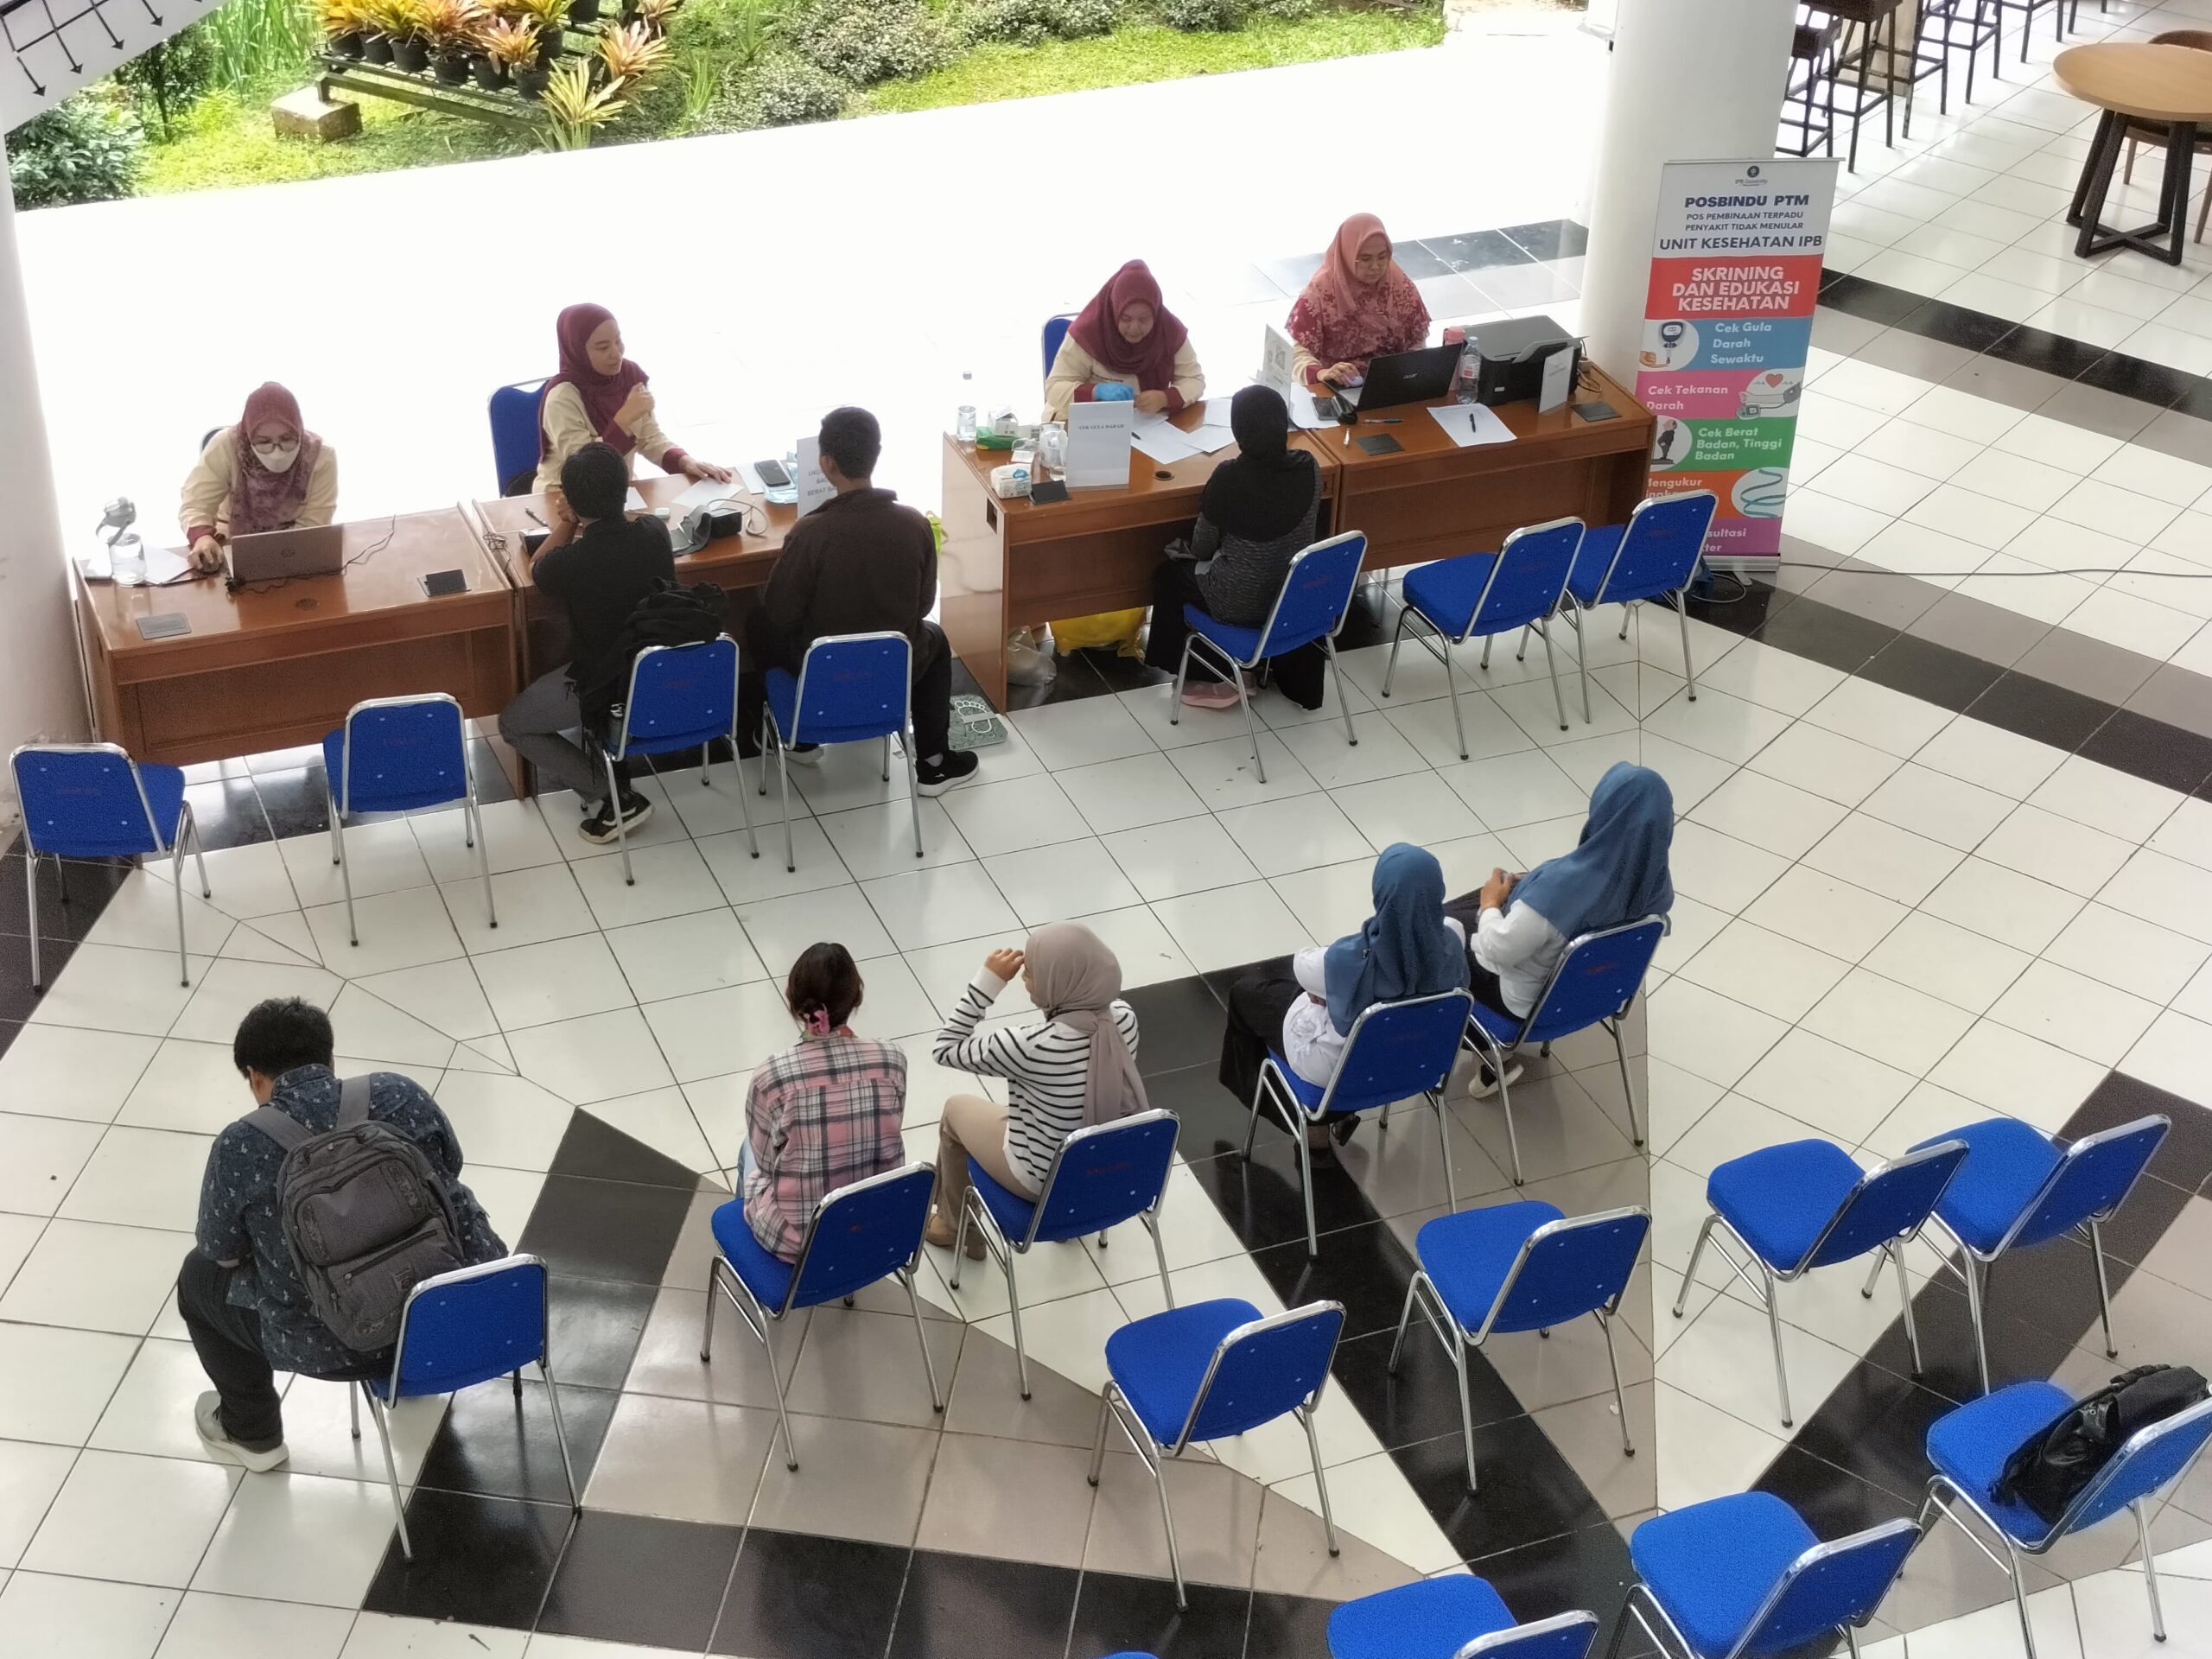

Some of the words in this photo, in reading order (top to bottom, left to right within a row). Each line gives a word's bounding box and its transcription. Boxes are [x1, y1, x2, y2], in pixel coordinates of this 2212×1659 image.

[1685, 195, 1768, 207] POSBINDU
[1774, 194, 1809, 207] PTM
[1707, 212, 1761, 220] PEMBINAAN
[1660, 238, 1697, 250] UNIT
[1701, 236, 1794, 249] KESEHATAN
[1799, 235, 1822, 247] IPB
[1692, 266, 1783, 282] SKRINING
[1672, 283, 1715, 296] DAN
[1719, 281, 1800, 296] EDUKASI
[1678, 296, 1789, 311] KESEHATAN
[1715, 322, 1739, 333] Cek
[1743, 321, 1772, 332] Gula
[1713, 339, 1751, 348] Darah
[1710, 353, 1764, 365] Sewaktu
[1648, 385, 1672, 395] Cek
[1675, 385, 1729, 394] Tekanan
[1646, 401, 1684, 410] Darah
[1698, 428, 1722, 437] Cek
[1725, 427, 1758, 436] Berat
[1696, 439, 1739, 449] Badan,
[1744, 438, 1783, 450] Tinggi
[1694, 451, 1735, 461] Badan
